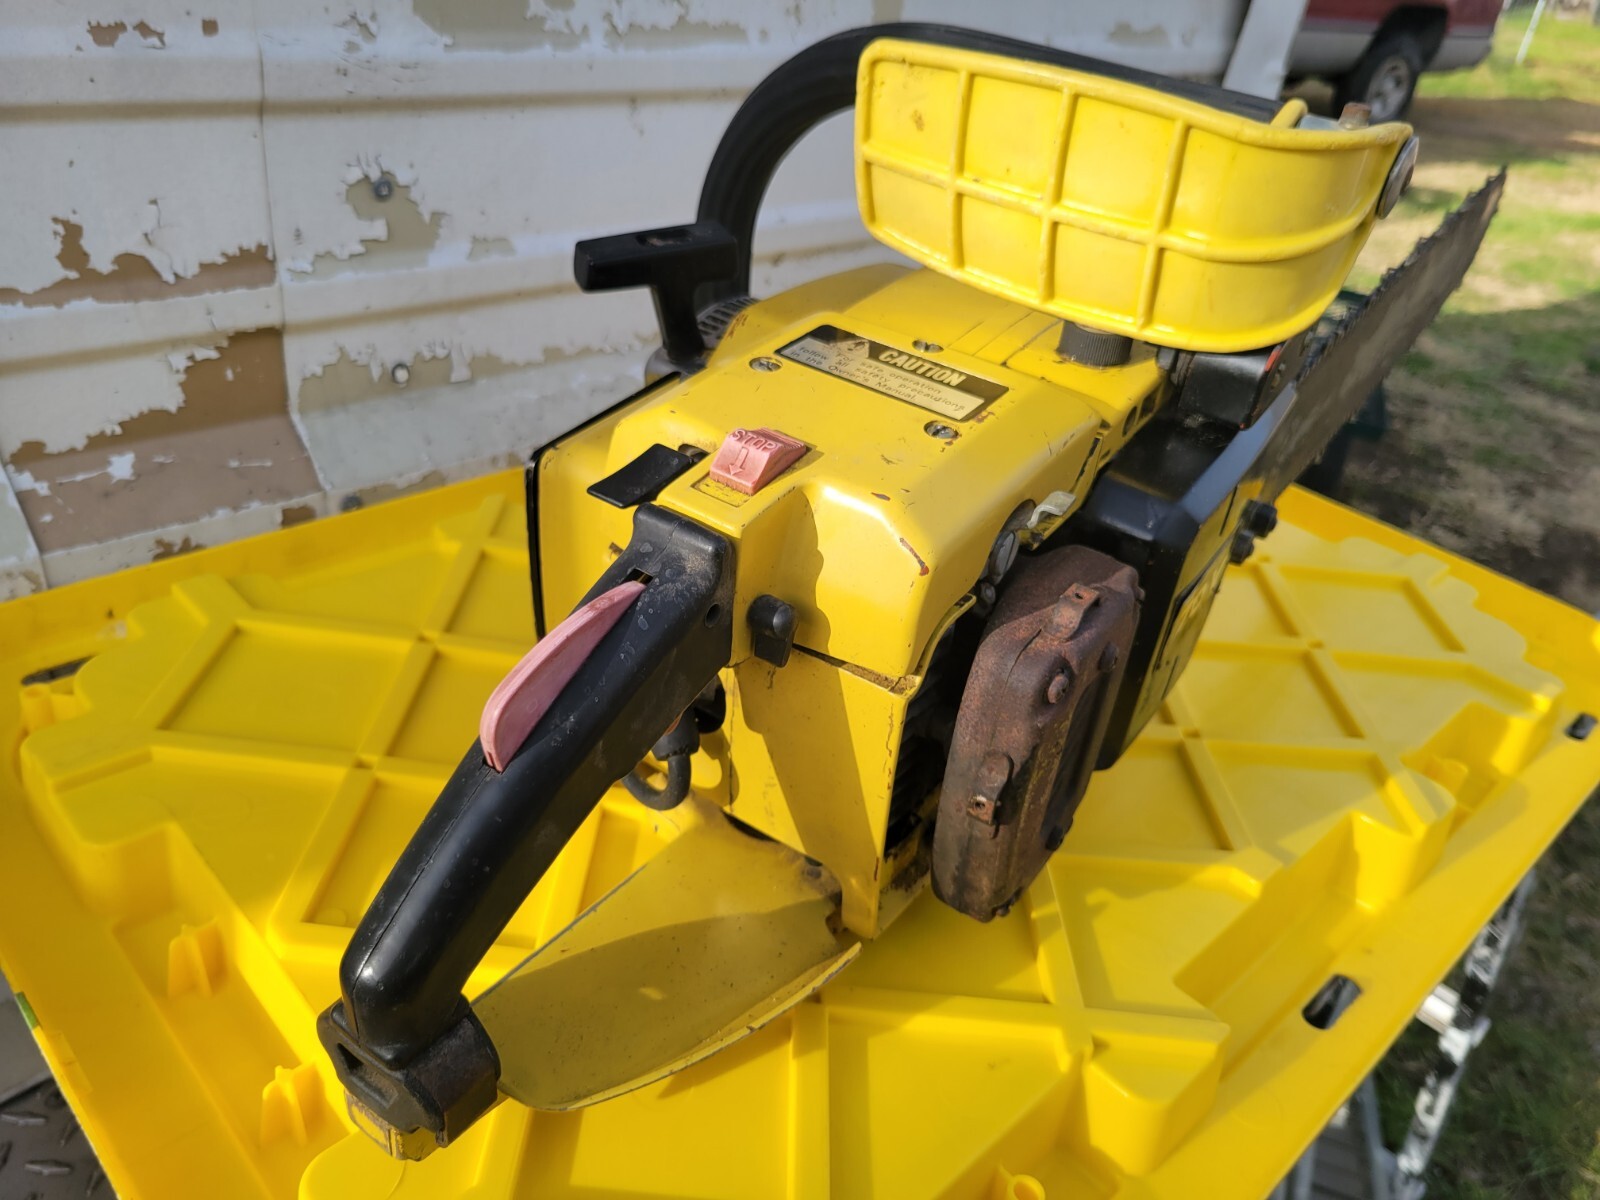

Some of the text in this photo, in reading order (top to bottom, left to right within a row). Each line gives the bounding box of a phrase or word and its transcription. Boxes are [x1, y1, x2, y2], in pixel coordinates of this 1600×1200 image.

[806, 356, 823, 366] the
[828, 365, 870, 383] Owner's
[835, 359, 850, 368] all
[856, 367, 891, 383] safety
[836, 353, 942, 395] For safe operation
[878, 350, 967, 387] CAUTION
[731, 429, 777, 451] STOP
